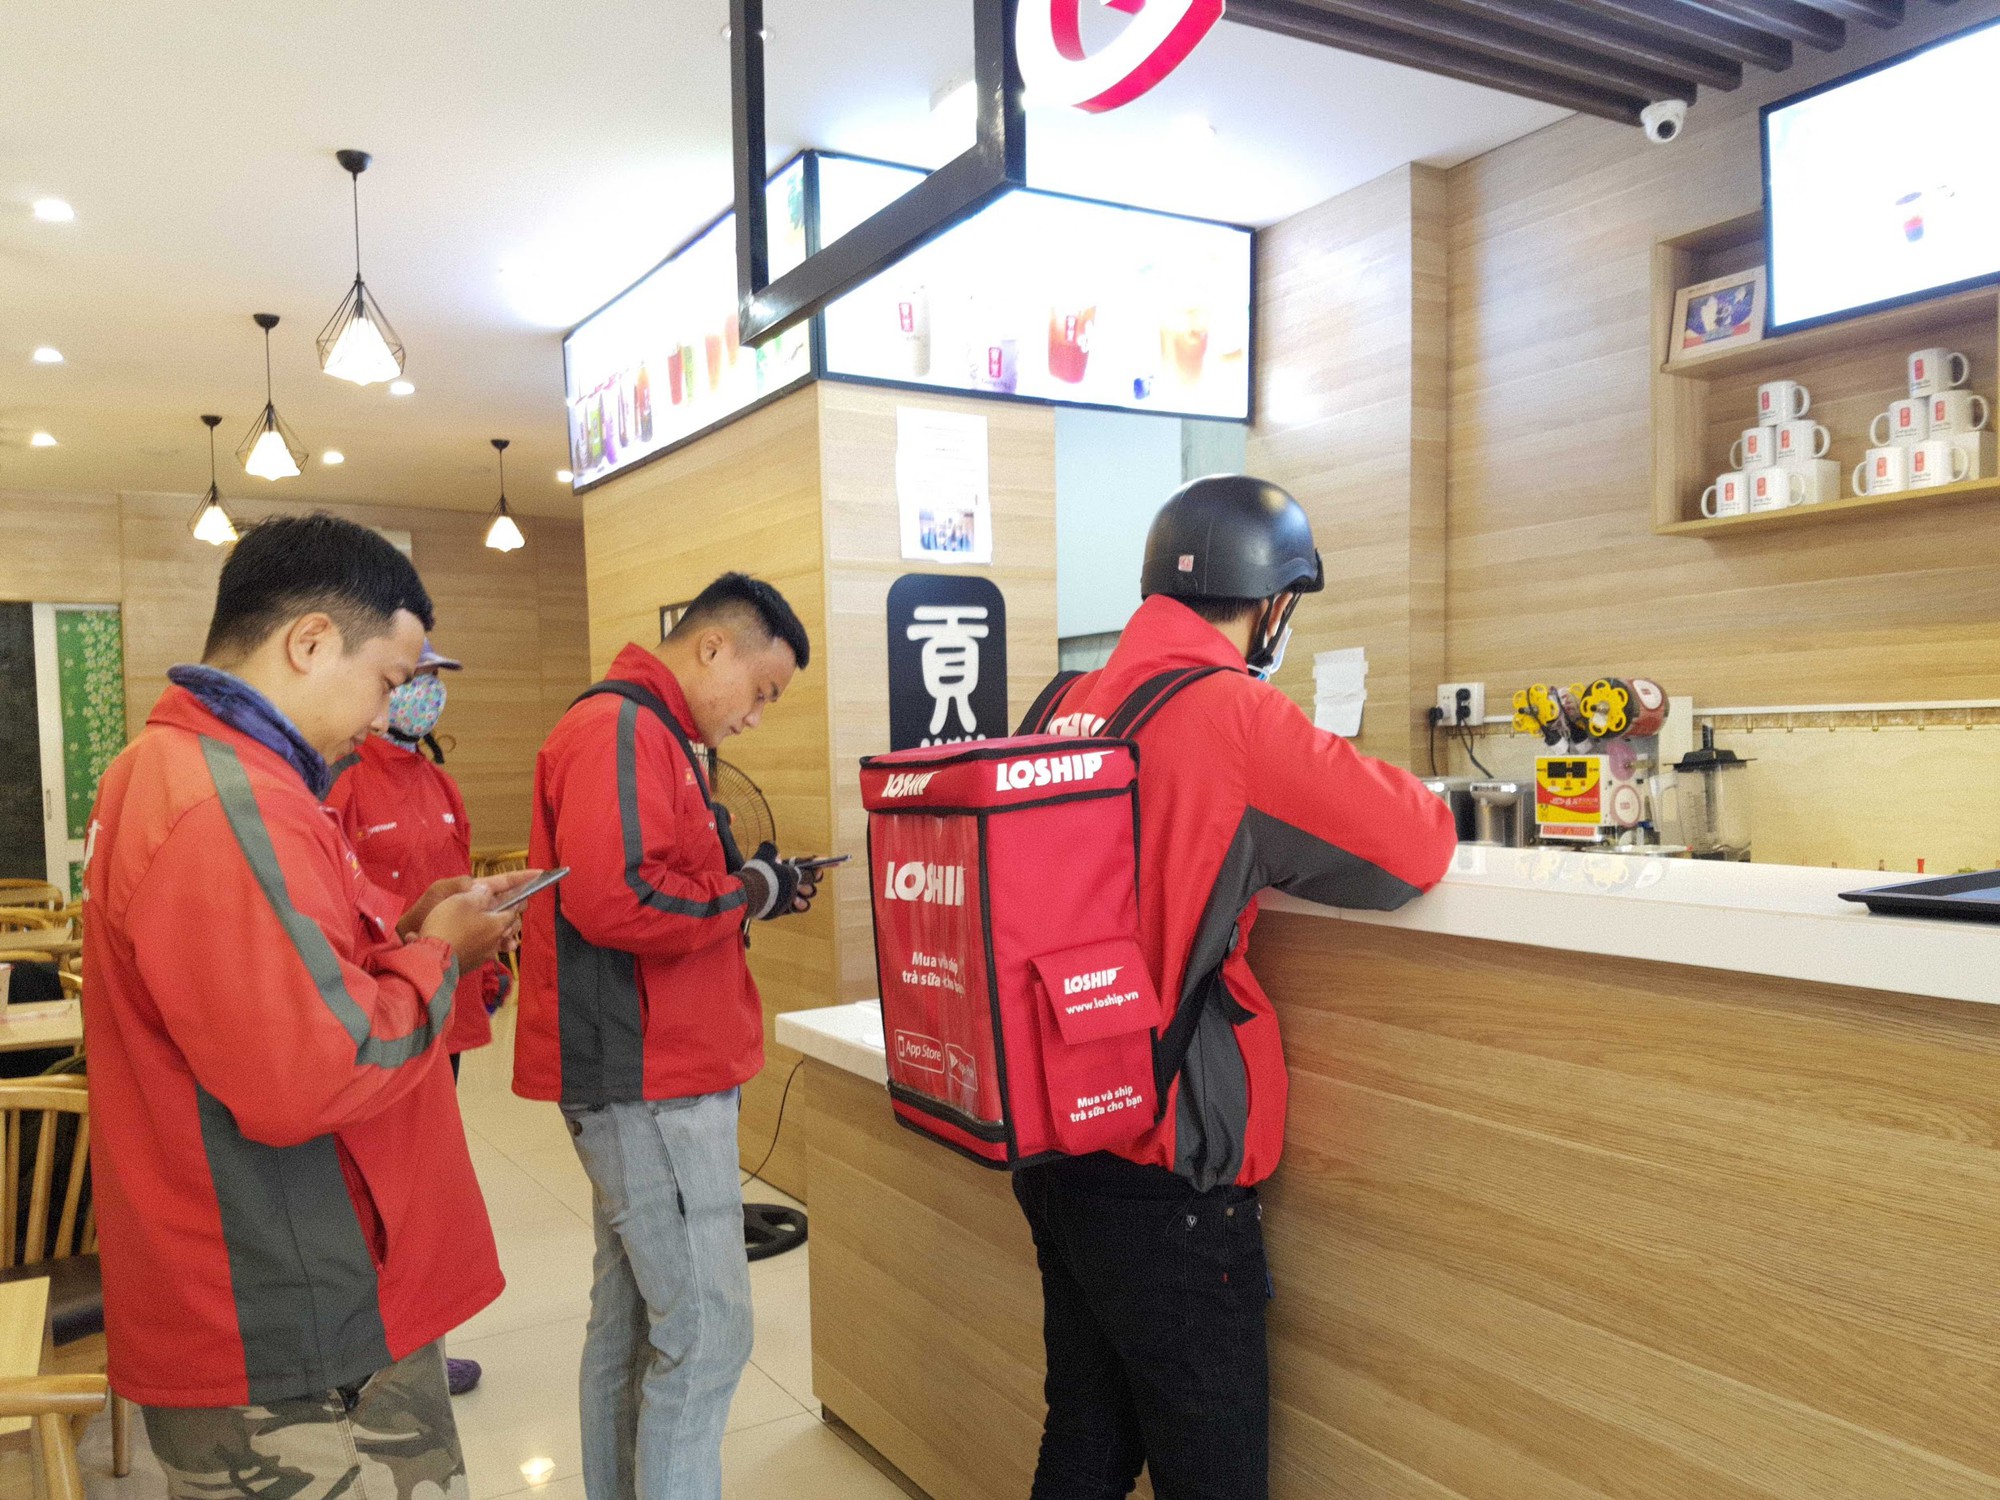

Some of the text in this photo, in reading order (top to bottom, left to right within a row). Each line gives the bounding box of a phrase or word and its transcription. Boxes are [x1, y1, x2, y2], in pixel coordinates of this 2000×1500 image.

[996, 751, 1114, 791] LOSHIP
[881, 770, 942, 798] LOSHIP
[912, 951, 937, 968] Mua
[902, 969, 919, 984] trà
[1064, 966, 1124, 995] LOSHIP
[1065, 991, 1139, 1015] www.loship.vn
[906, 1040, 941, 1061] App Store
[1070, 1110, 1087, 1122] trà
[1107, 1101, 1124, 1112] cho
[1126, 1095, 1142, 1109] bạn
[1077, 1085, 1133, 1109] Mua và ship
